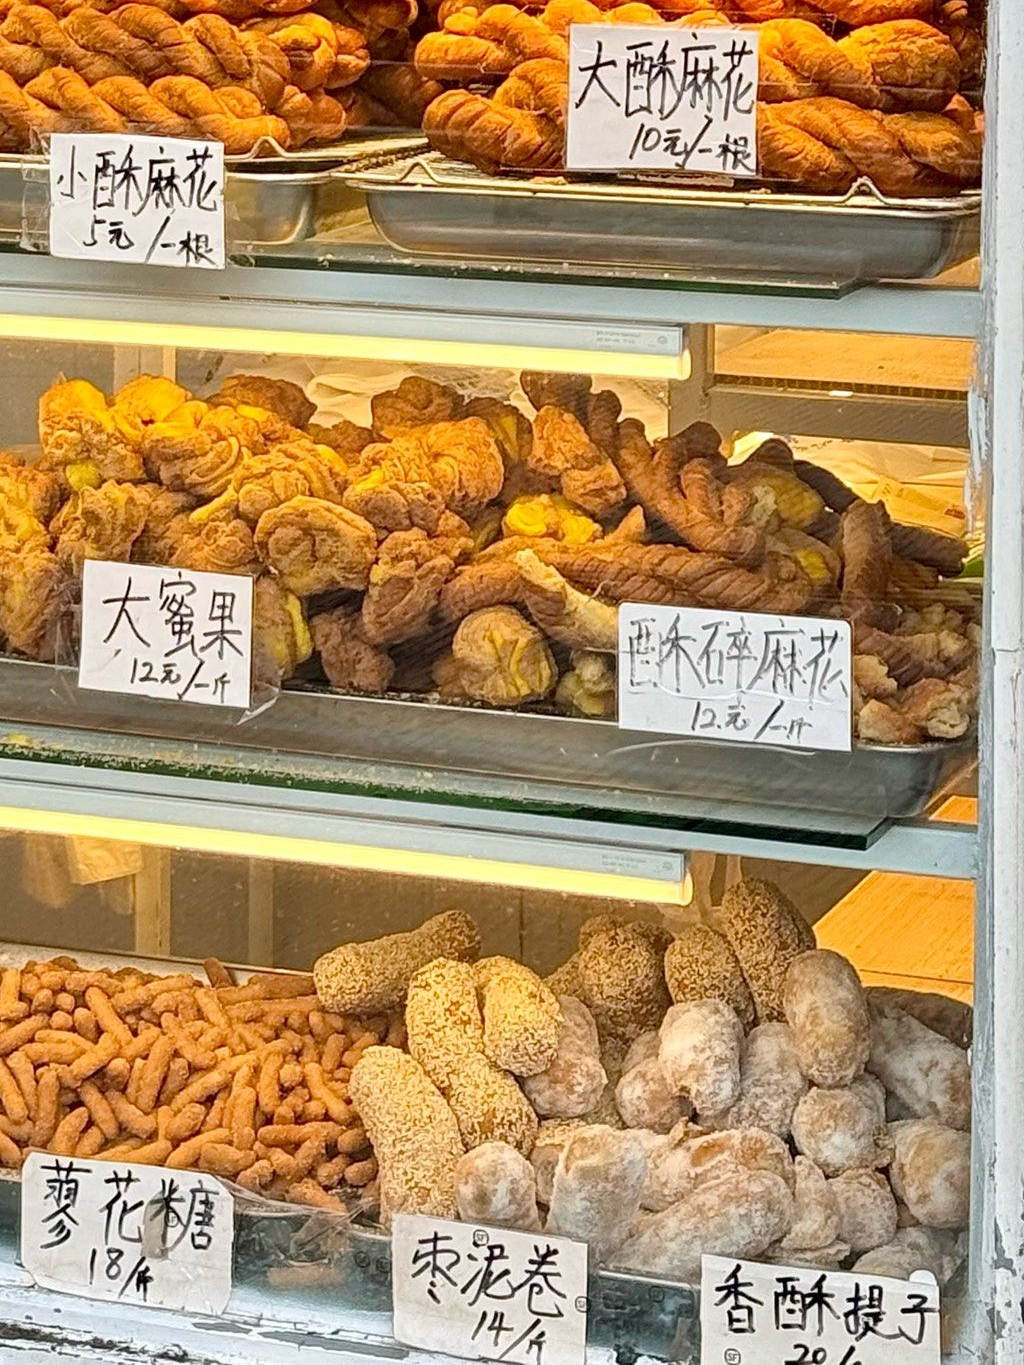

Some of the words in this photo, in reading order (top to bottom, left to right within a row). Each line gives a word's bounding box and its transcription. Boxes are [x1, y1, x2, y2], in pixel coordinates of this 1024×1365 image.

[575, 32, 755, 122] 大酥麻花
[57, 144, 218, 217] 小酥麻花
[102, 571, 244, 660] 大蜜果
[628, 613, 848, 711] 酥碎麻花
[40, 1159, 220, 1252] 蓼花糖
[411, 1231, 567, 1318] 枣泥卷
[714, 1263, 939, 1345] 香酥提子
